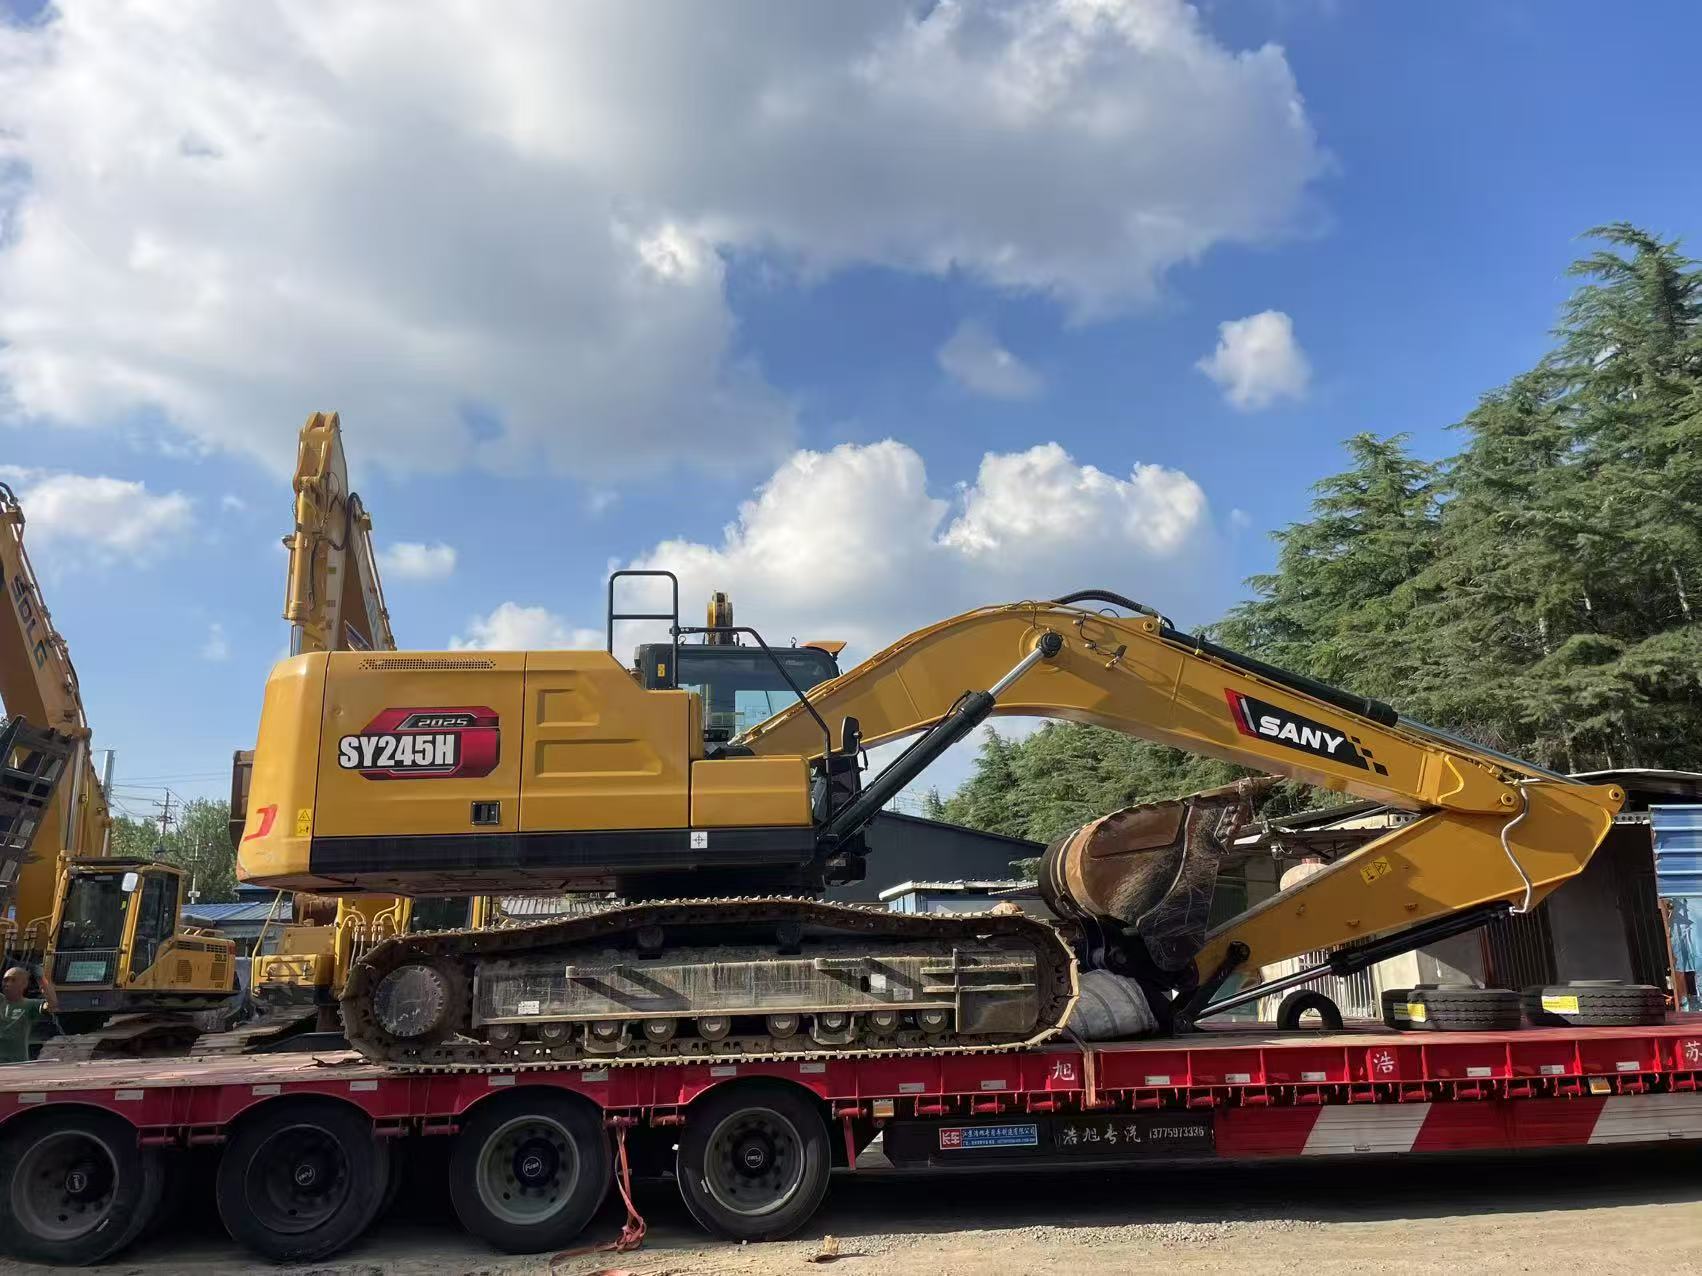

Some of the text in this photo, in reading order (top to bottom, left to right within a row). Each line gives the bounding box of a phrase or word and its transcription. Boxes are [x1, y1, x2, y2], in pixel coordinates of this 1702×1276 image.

[418, 718, 468, 727] 2025
[1259, 715, 1345, 754] SANY
[339, 735, 456, 768] SY245H
[1373, 1051, 1395, 1073] 浩
[1684, 1040, 1702, 1062] 苏
[1052, 1060, 1075, 1080] 旭
